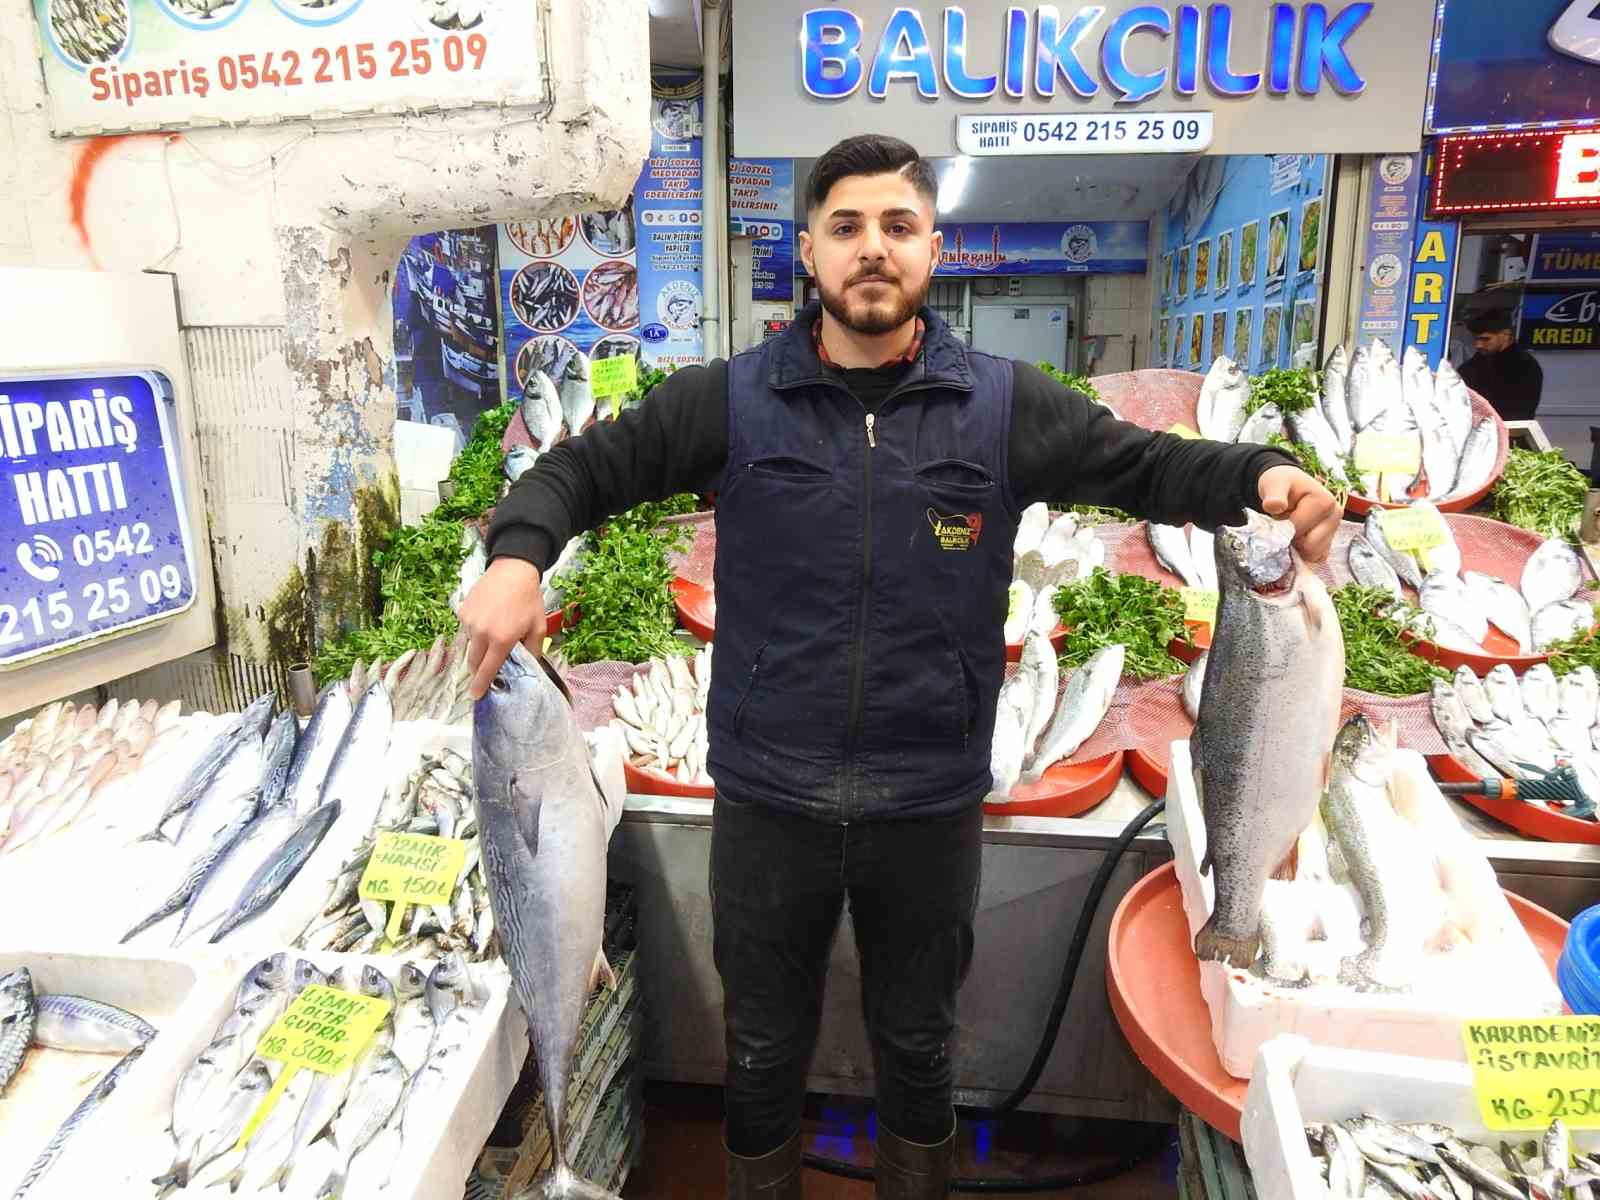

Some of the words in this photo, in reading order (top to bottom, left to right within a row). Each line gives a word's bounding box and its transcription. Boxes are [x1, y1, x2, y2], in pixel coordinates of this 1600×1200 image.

[91, 61, 209, 104] Sipariş
[218, 51, 302, 90] 0542
[313, 42, 376, 82] 215
[389, 37, 431, 76] 25
[444, 33, 487, 71] 09
[800, 2, 1374, 103] BALIKÇILIK
[971, 119, 1018, 135] SİPARİŞ
[1023, 121, 1078, 142] 0542
[1085, 120, 1127, 141] 215
[1137, 119, 1165, 140] 25
[1172, 119, 1200, 140] 09
[0, 388, 138, 457] İPARİŞ
[14, 461, 128, 526] HATTI
[72, 522, 154, 567] 0542
[0, 590, 74, 646] 215
[82, 576, 131, 621] 25
[139, 564, 182, 605] 09
